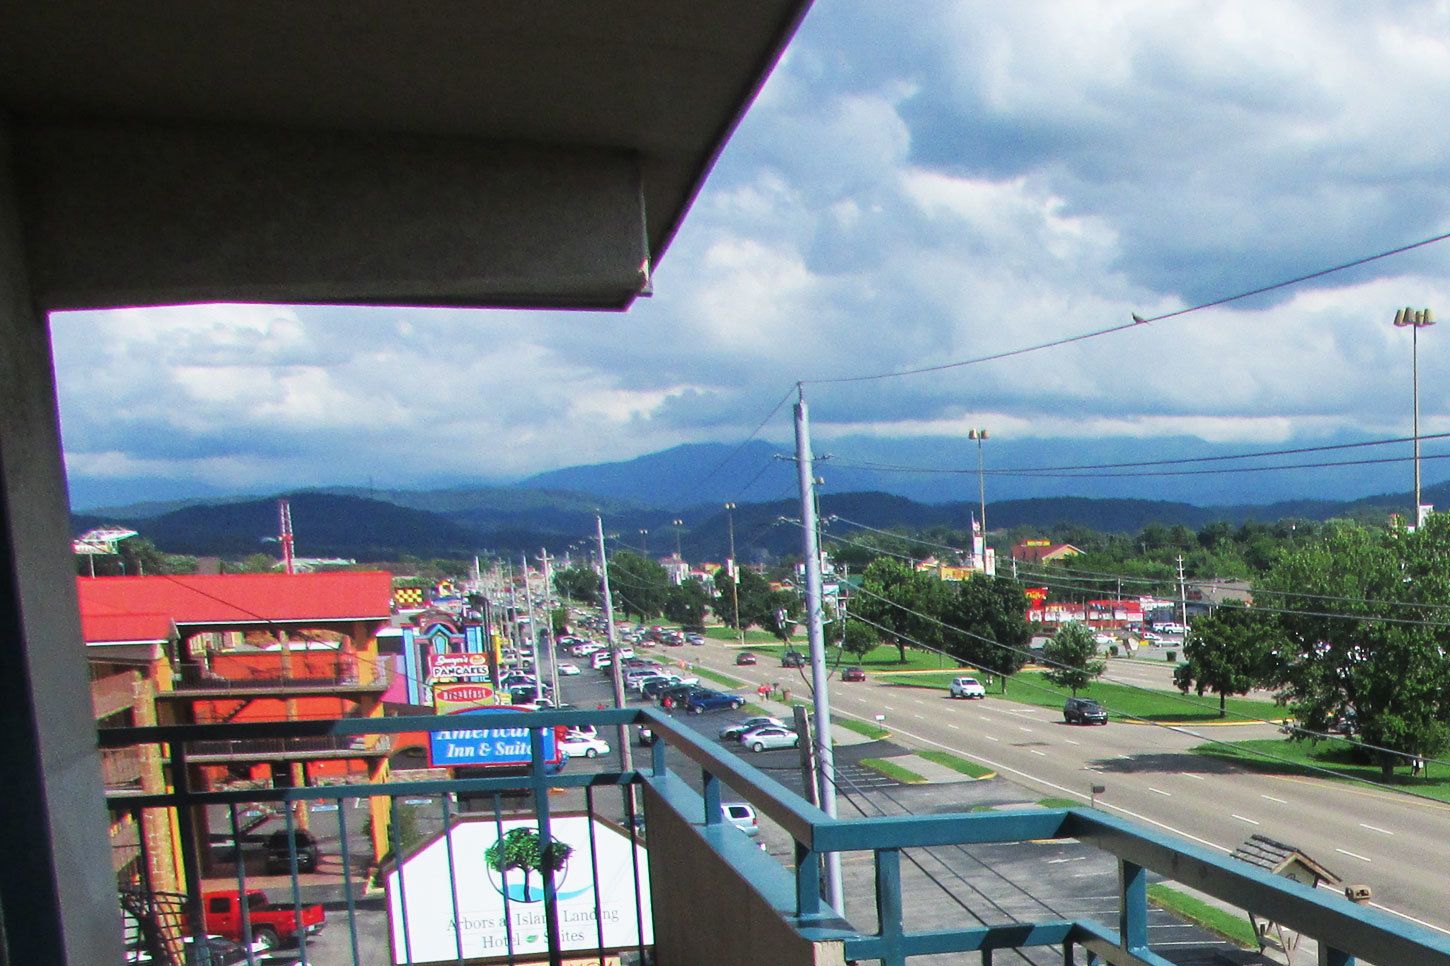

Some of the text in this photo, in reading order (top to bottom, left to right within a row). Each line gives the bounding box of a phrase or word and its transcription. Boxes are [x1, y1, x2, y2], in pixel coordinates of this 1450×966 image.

[434, 666, 487, 676] PANCAKES
[447, 743, 475, 758] Inn
[480, 742, 492, 757] &
[563, 907, 620, 923] Landng
[543, 930, 585, 945] Sites
